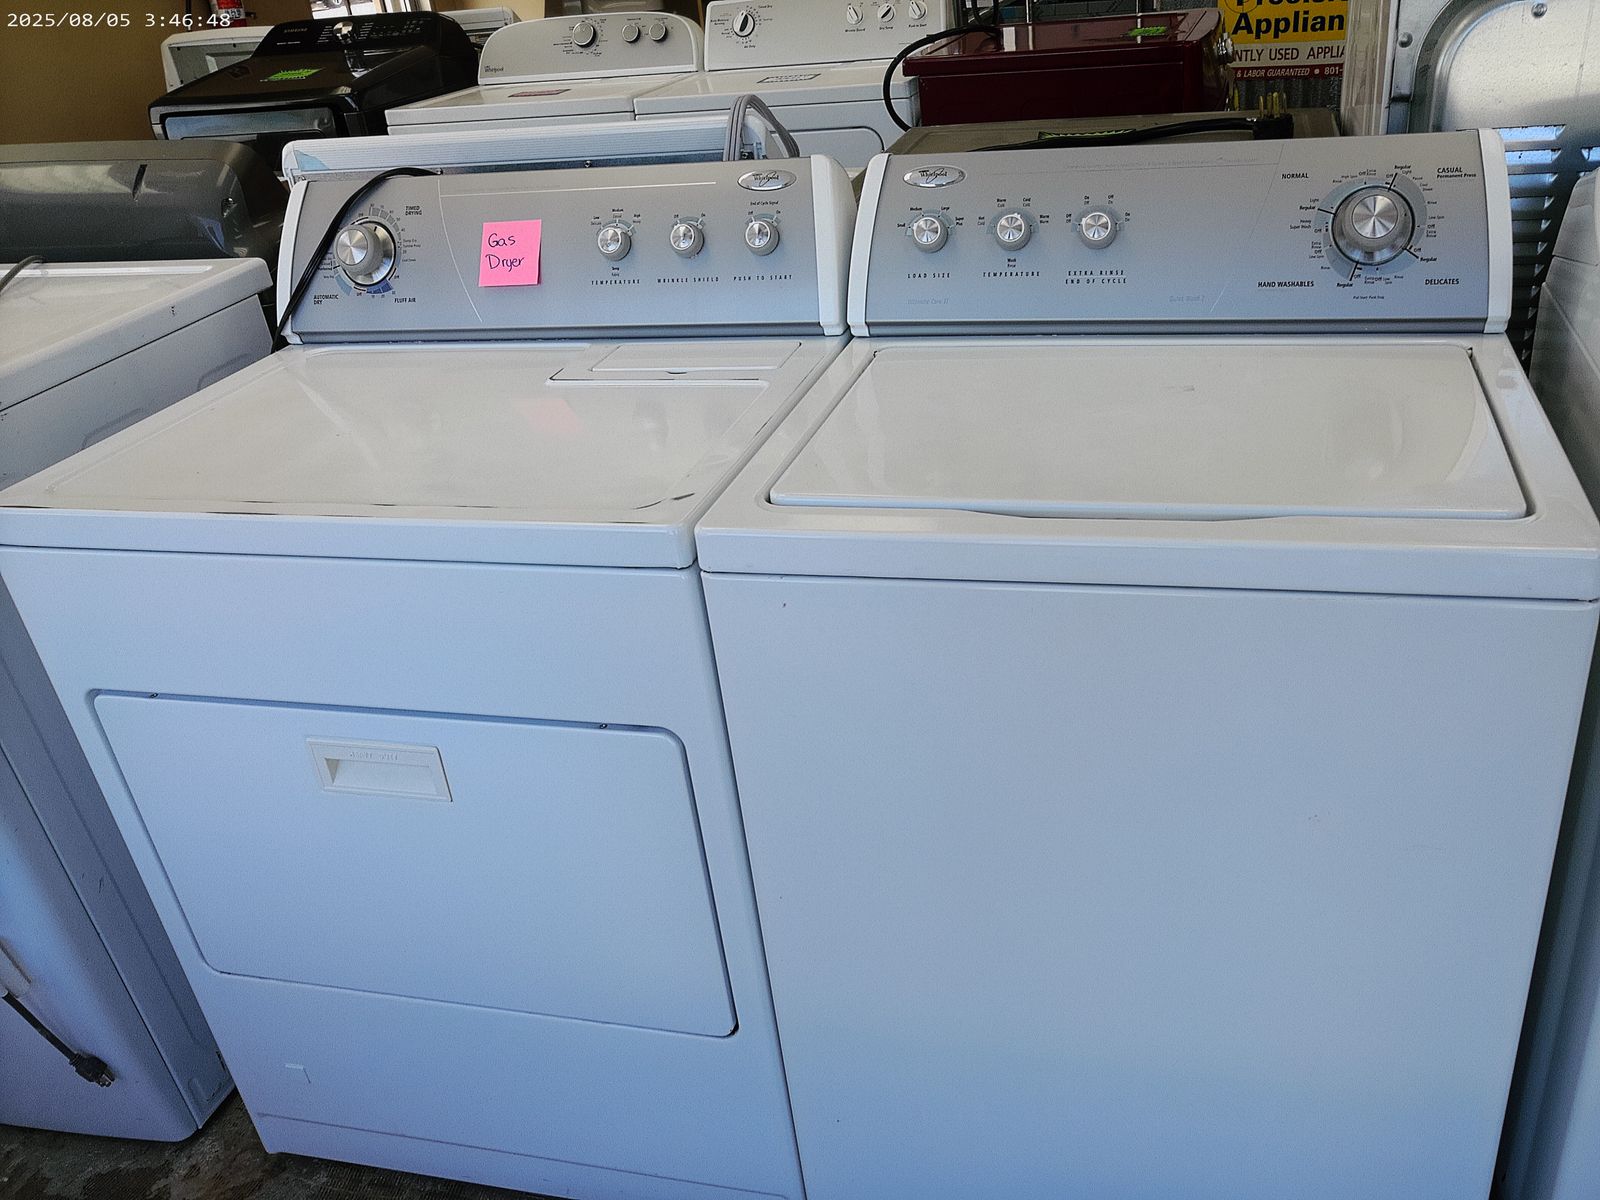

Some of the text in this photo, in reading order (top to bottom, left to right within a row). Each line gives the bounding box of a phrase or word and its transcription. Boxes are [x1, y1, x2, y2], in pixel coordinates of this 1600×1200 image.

[1232, 10, 1345, 40] Applian
[1268, 47, 1299, 61] USED
[1243, 69, 1266, 78] LABOR
[1267, 67, 1311, 77] GUARANTEED
[1281, 172, 1309, 180] NORMAL
[488, 232, 516, 248] Gas
[485, 253, 525, 273] Dryer
